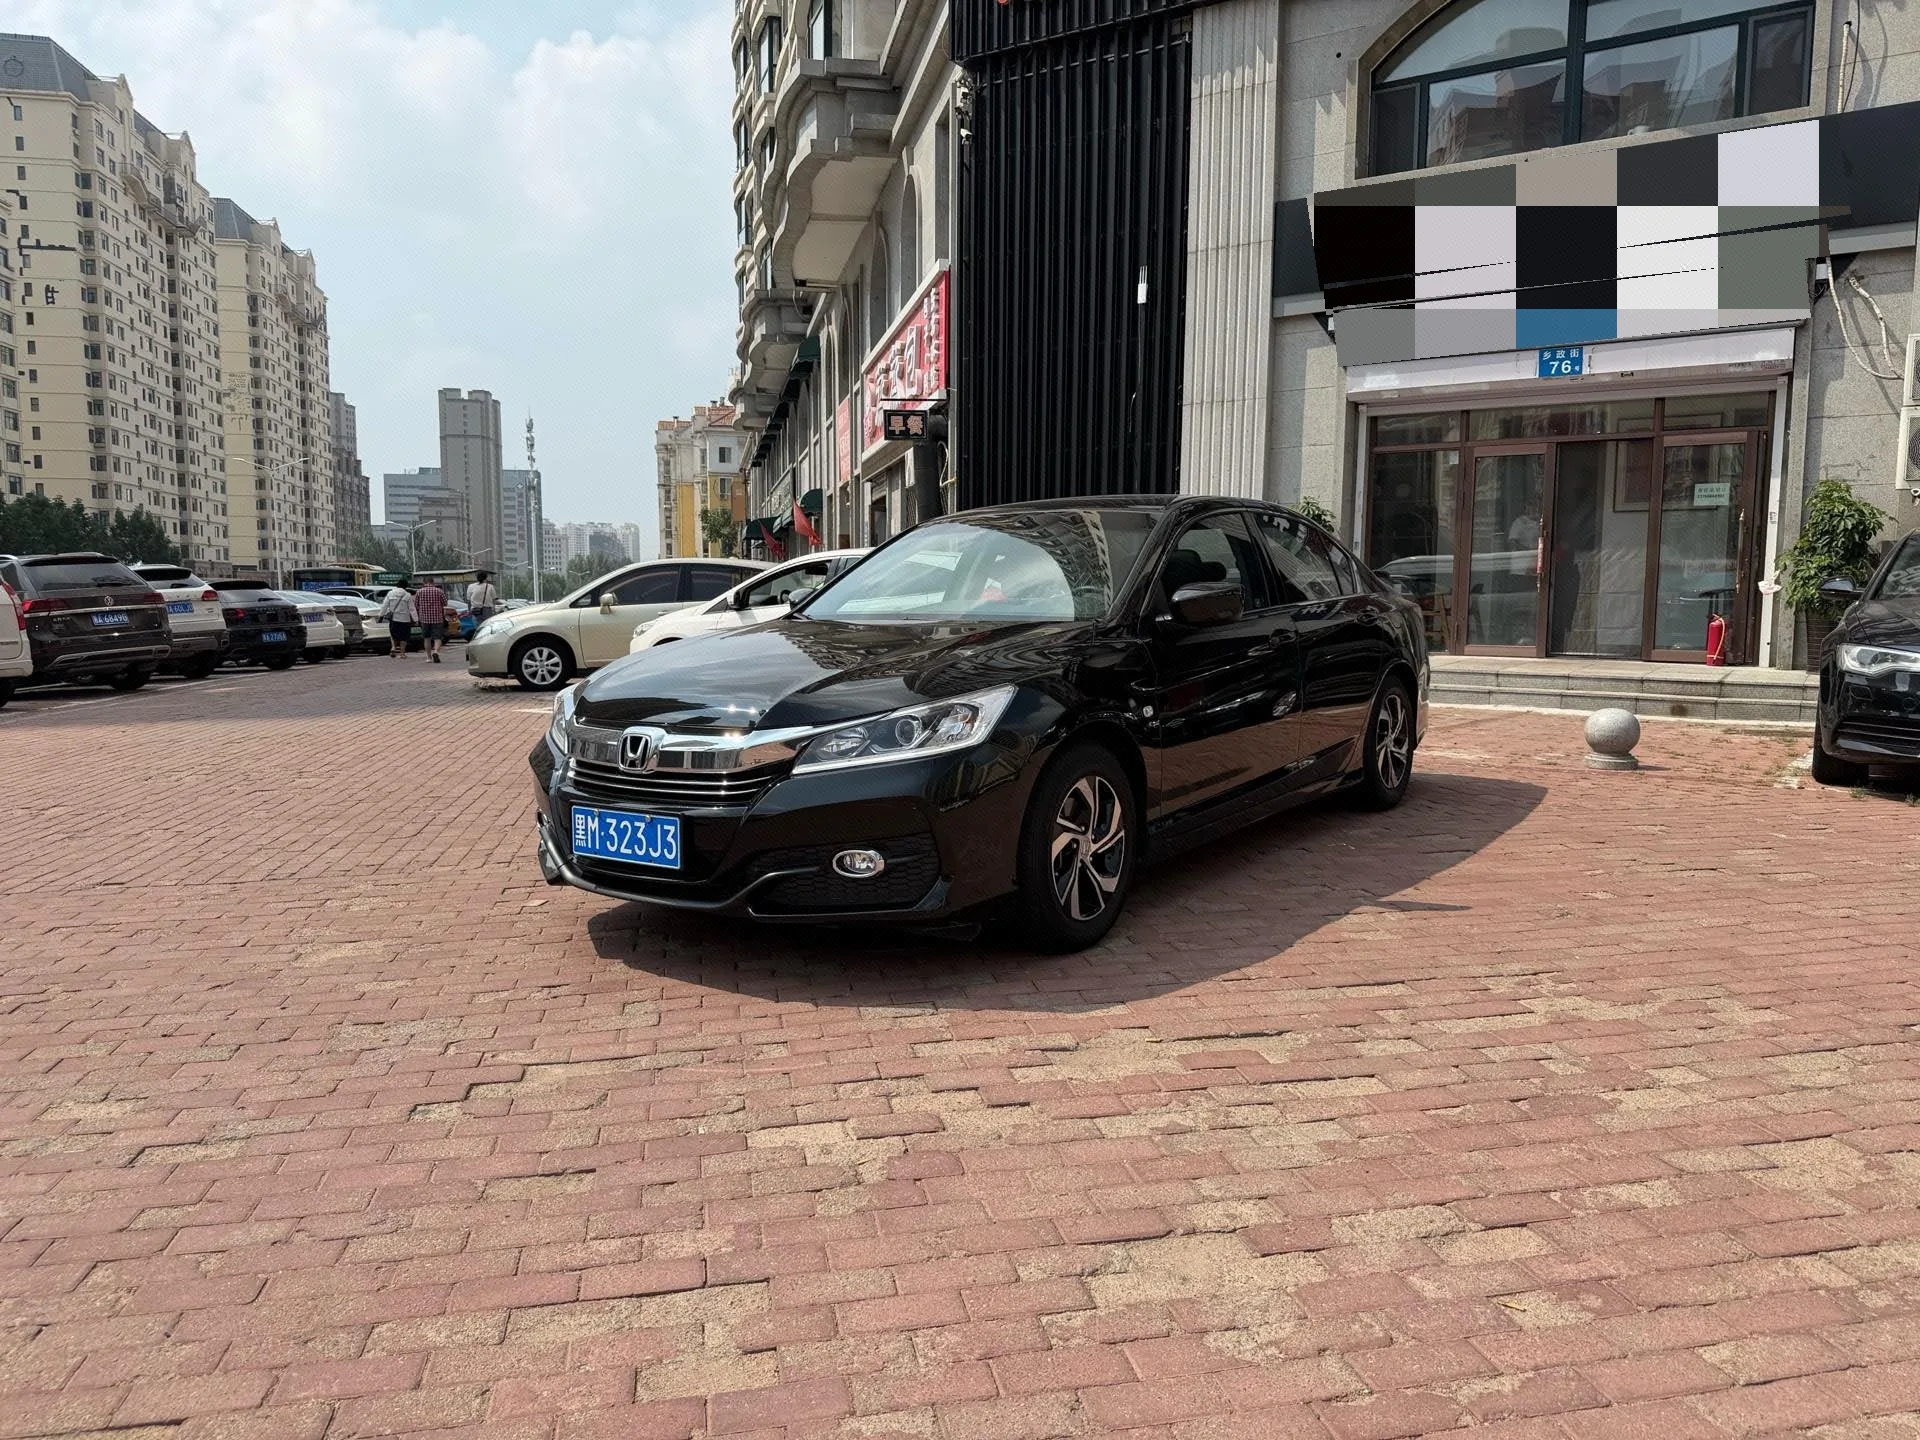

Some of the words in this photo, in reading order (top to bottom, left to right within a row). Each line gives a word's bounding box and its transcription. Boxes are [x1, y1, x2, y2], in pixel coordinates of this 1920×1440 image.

[1542, 348, 1580, 360] 乡政街
[888, 415, 924, 435] 早餐
